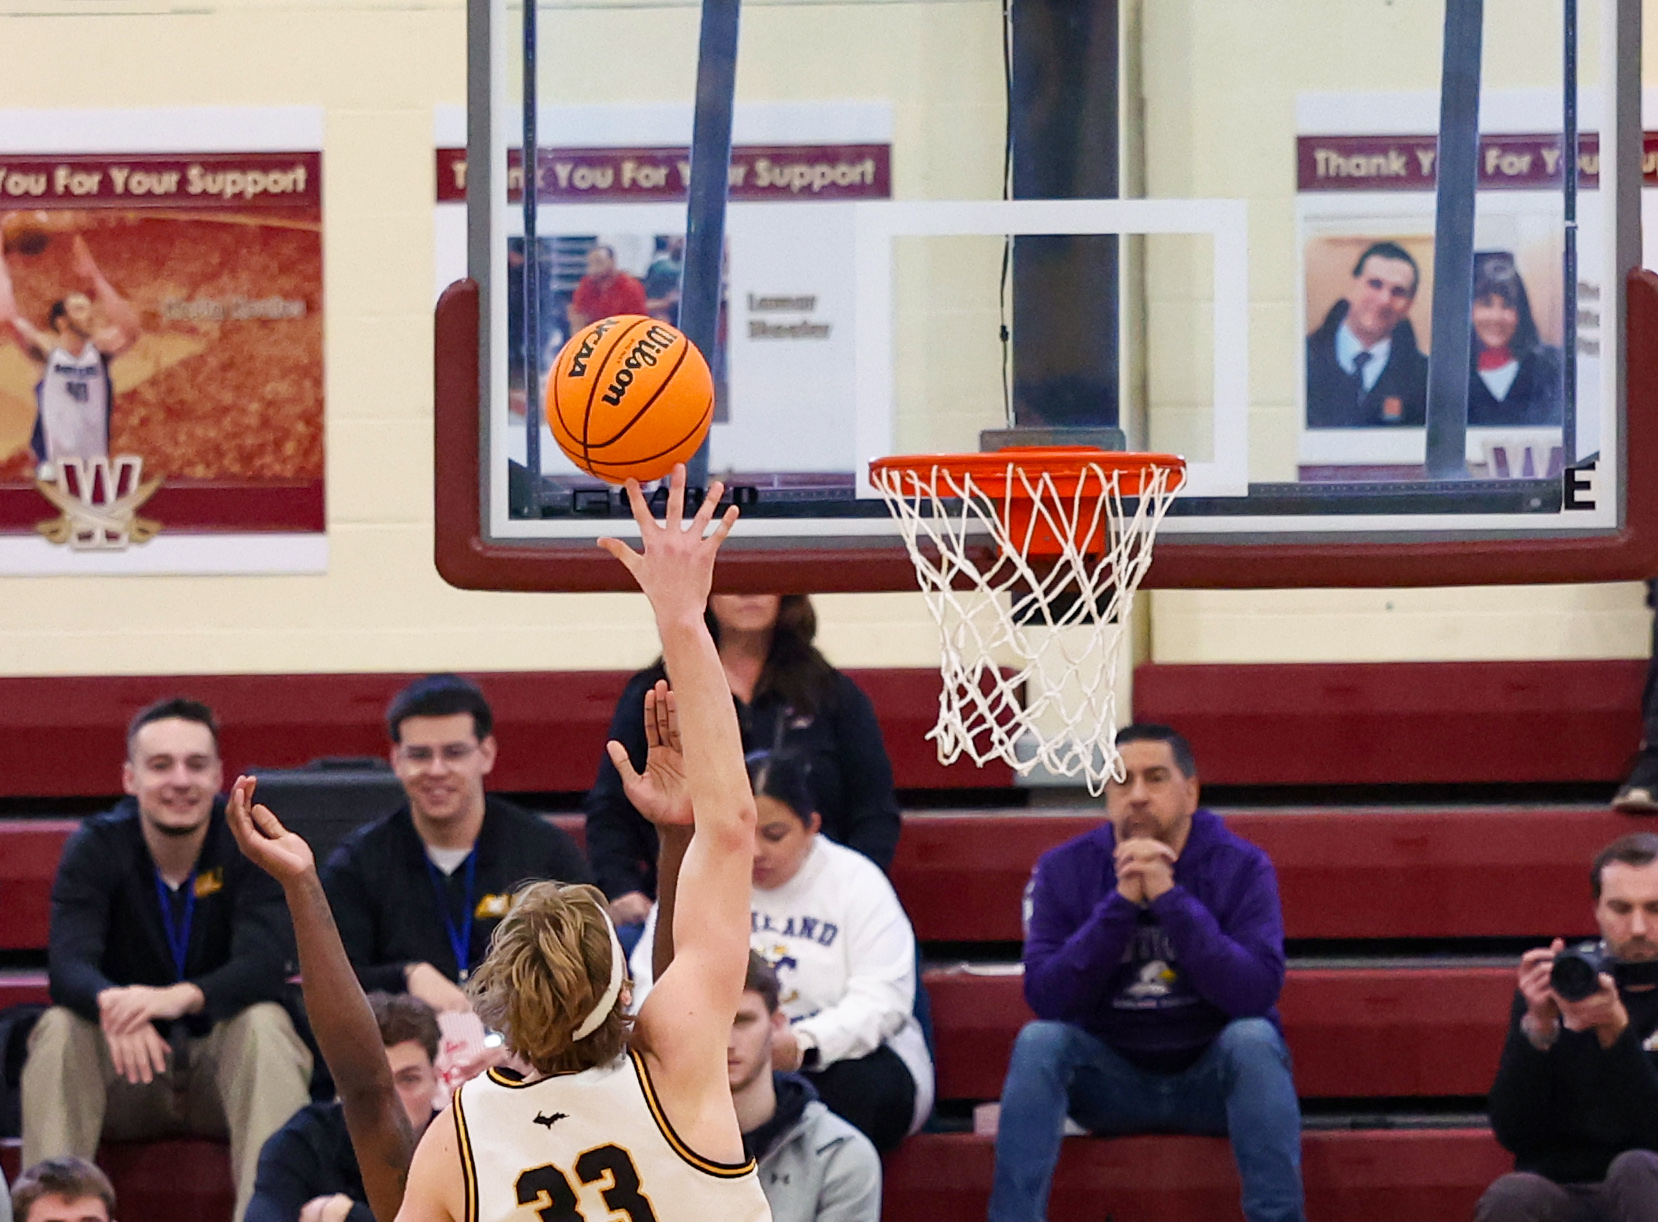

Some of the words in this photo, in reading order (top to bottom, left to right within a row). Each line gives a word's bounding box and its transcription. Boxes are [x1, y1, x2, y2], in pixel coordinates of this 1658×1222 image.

[554, 163, 614, 190] You
[621, 160, 669, 189] For
[755, 158, 876, 193] Support
[1314, 148, 1407, 177] Thank
[1484, 147, 1532, 176] For
[54, 164, 102, 195] For
[109, 166, 182, 195] Your
[186, 164, 307, 199] Support
[568, 319, 620, 378] NCAA
[600, 325, 678, 407] Wilson
[1564, 461, 1596, 510] E
